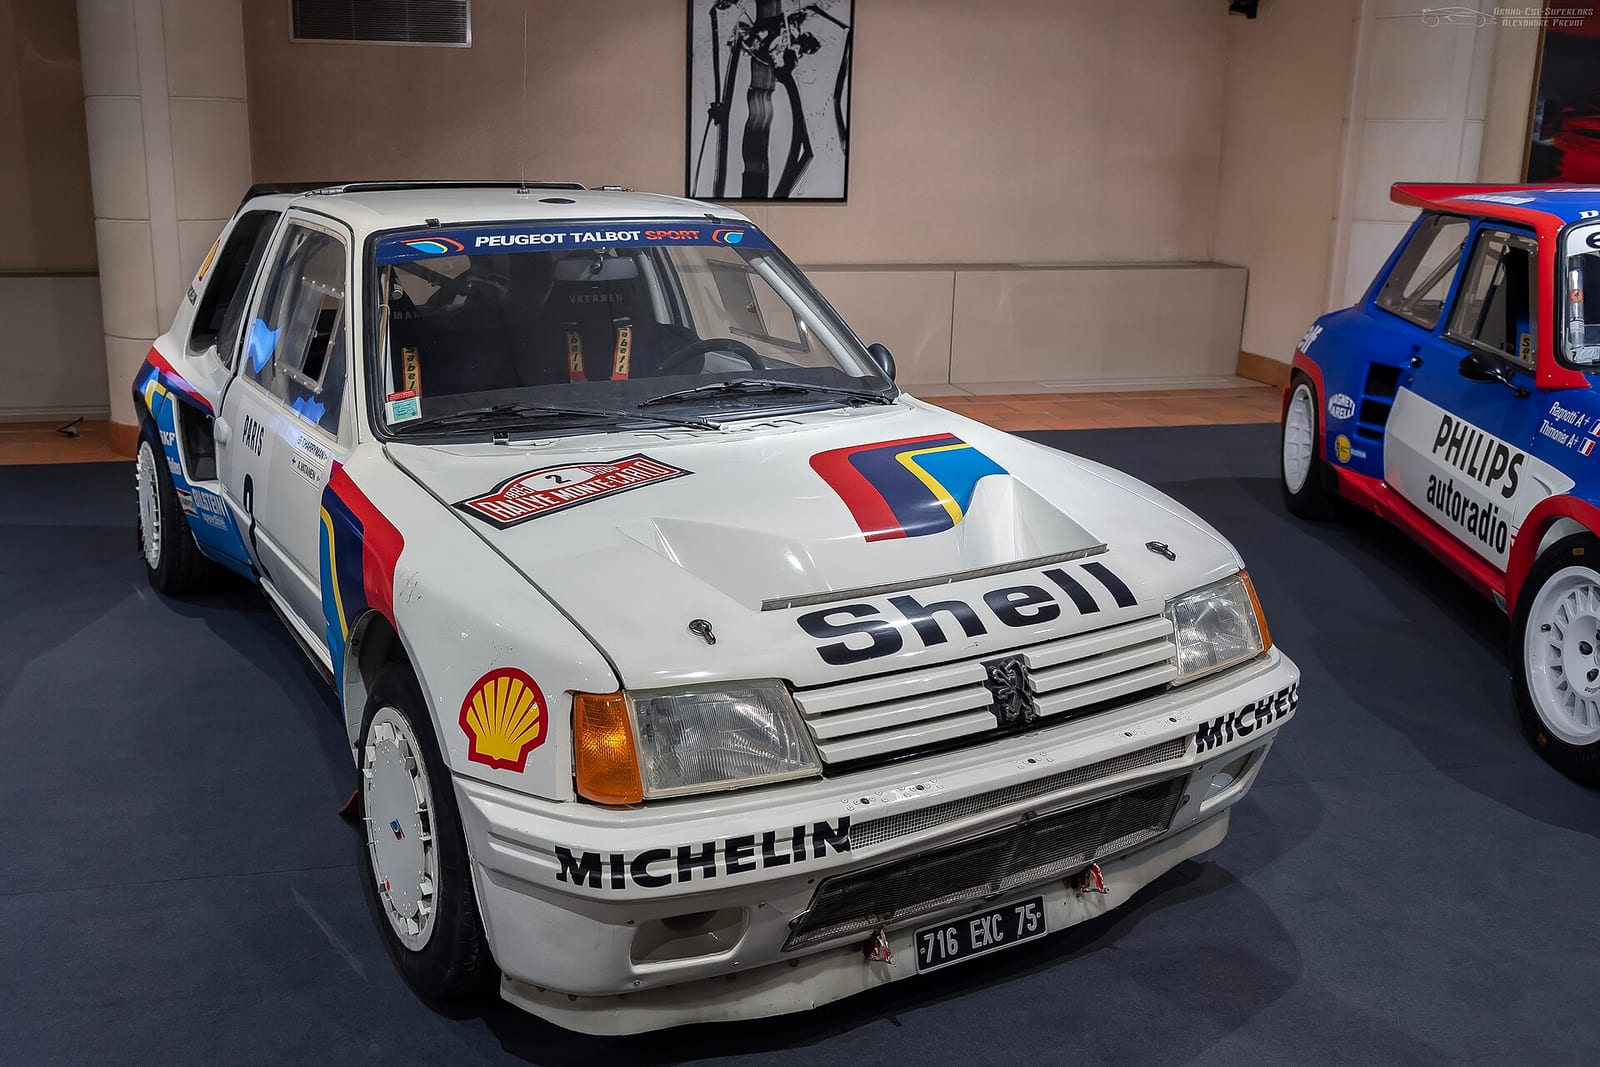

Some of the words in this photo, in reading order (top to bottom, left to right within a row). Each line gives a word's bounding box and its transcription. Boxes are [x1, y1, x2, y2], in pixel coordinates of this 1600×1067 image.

[475, 233, 567, 248] PEUGEOT
[570, 231, 641, 243] TALBOT
[645, 230, 699, 241] SPORT
[569, 293, 624, 304] VATANEN
[1548, 401, 1581, 425] Ragnotti
[241, 414, 265, 457] PARIS
[1432, 414, 1525, 499] PHILIPS
[476, 494, 561, 519] RALLYE
[503, 482, 537, 500] 1985
[545, 474, 572, 485] 2
[1426, 474, 1508, 555] autoradio
[796, 561, 1139, 666] Shell
[555, 816, 851, 890] MICHELIN
[923, 927, 958, 963] 716
[970, 914, 1004, 949] EXC
[1015, 903, 1038, 936] 75
